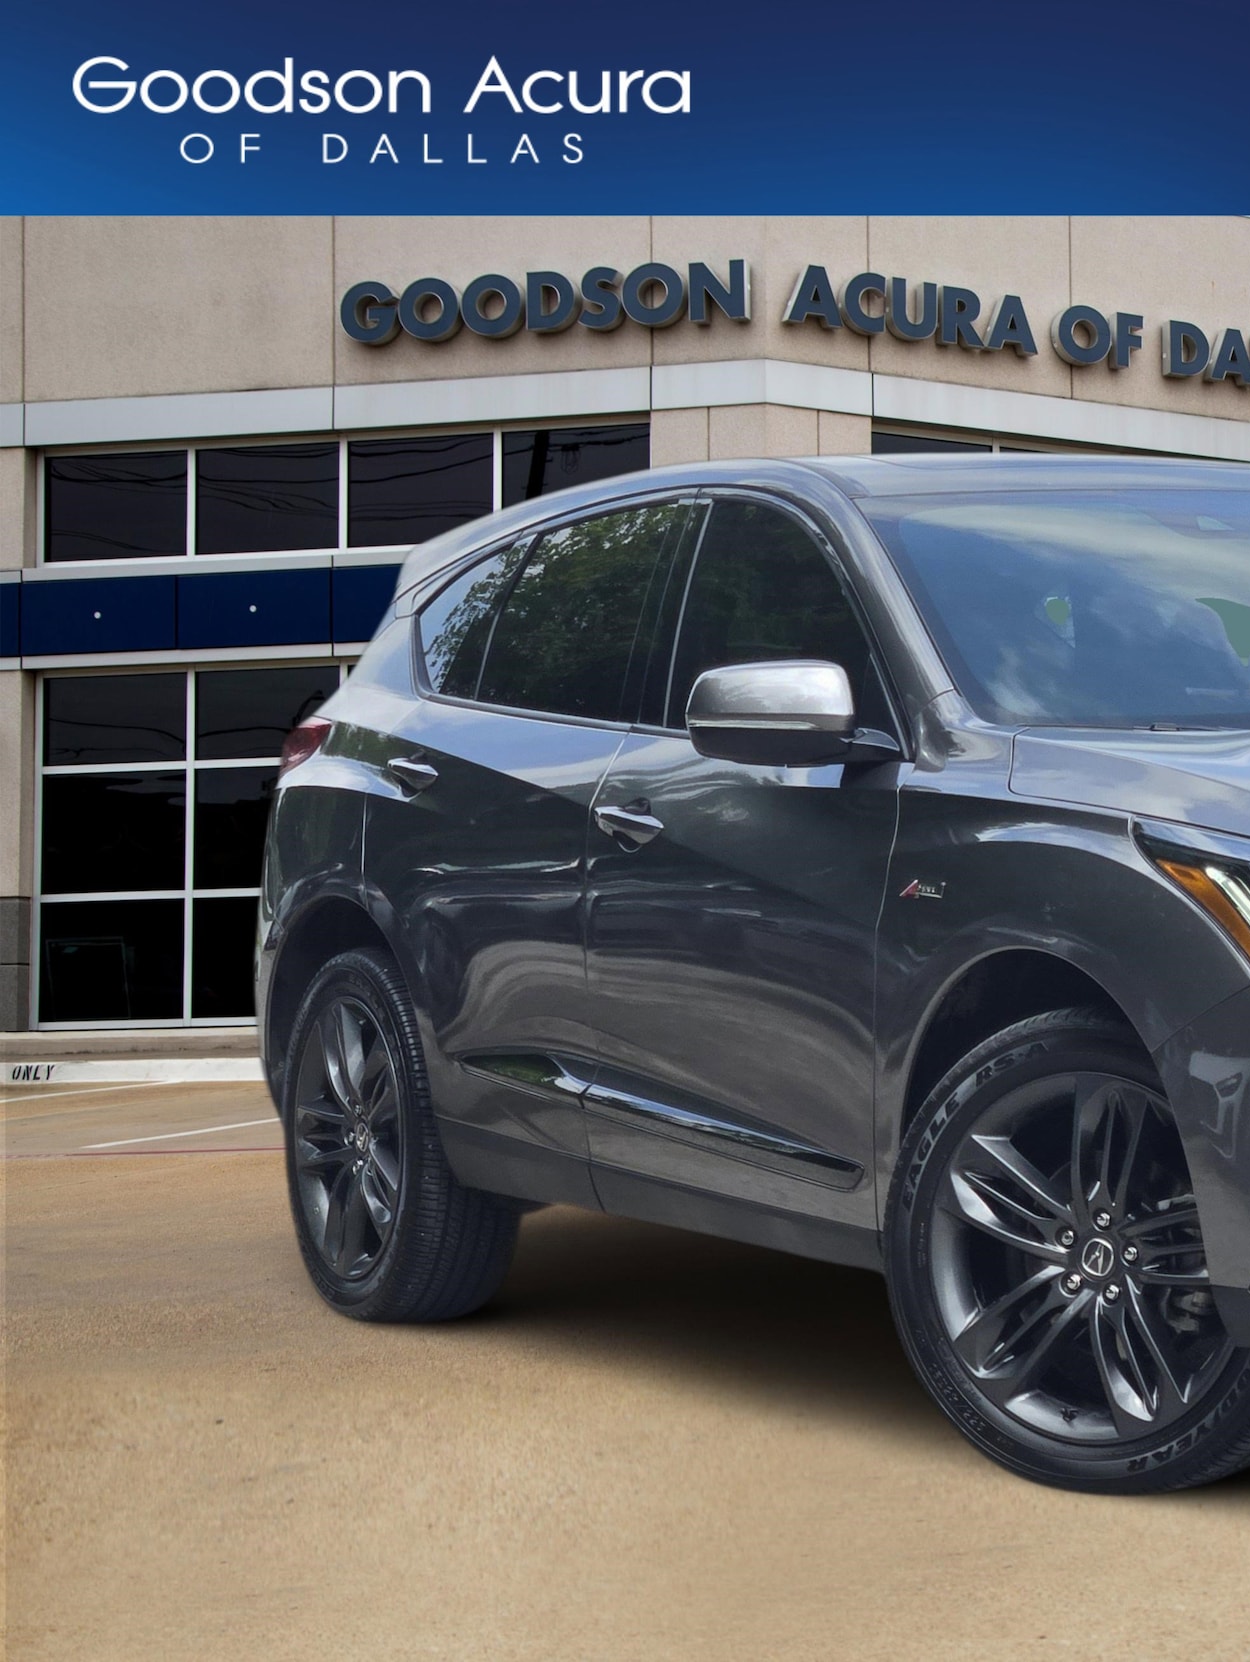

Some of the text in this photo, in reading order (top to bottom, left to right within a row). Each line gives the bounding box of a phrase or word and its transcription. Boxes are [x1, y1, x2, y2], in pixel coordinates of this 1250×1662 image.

[340, 259, 749, 346] GOODSON
[782, 264, 1037, 356] ACURA
[1053, 304, 1145, 369] OF
[12, 1064, 55, 1081] ONLY
[902, 1091, 960, 1212] EAGLE
